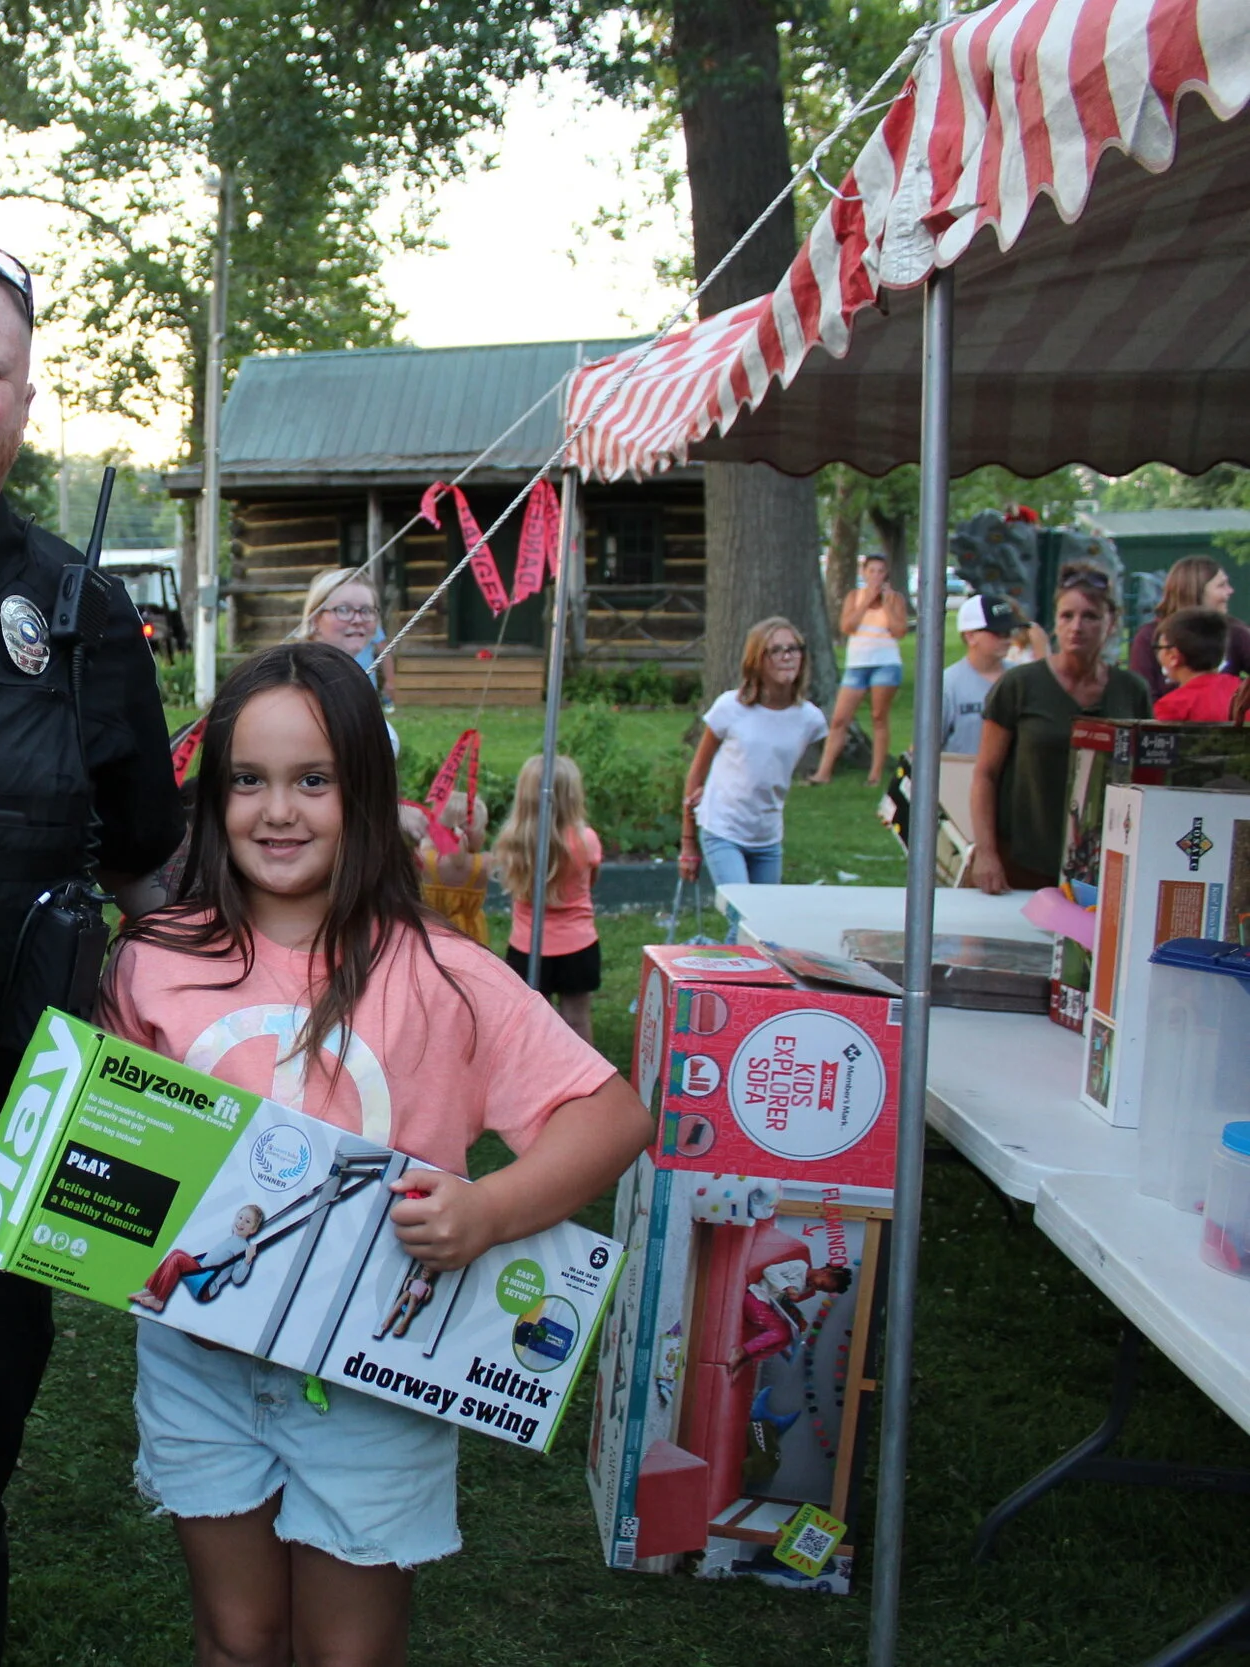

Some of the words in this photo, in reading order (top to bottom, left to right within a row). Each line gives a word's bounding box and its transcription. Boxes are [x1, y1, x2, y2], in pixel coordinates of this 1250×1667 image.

[1190, 818, 1203, 871] MOSAIC
[99, 1055, 241, 1124] playzone-fit
[745, 1057, 770, 1105] SOFA
[766, 1035, 797, 1132] EXPLORER
[822, 1069, 834, 1101] 4-PIECE
[84, 1103, 97, 1115] just
[96, 1107, 119, 1123] gravity
[118, 1115, 132, 1126] and
[113, 1101, 136, 1117] needed
[136, 1110, 147, 1121] for
[205, 1114, 234, 1132] Everyday
[840, 1105, 851, 1127] Mark
[78, 1116, 103, 1133] Storage
[102, 1124, 116, 1138] bag
[115, 1127, 142, 1146] included
[66, 1151, 111, 1180] PLAY.
[257, 1172, 287, 1189] WINNER
[56, 1178, 91, 1199] Active
[92, 1191, 123, 1212] today
[124, 1202, 141, 1217] for
[50, 1194, 58, 1204] a
[60, 1195, 101, 1222] healthy
[103, 1212, 154, 1238] tomorrow
[50, 1262, 60, 1272] top
[59, 1266, 76, 1277] panel
[53, 1274, 91, 1292] specifications
[516, 1269, 537, 1282] EASY
[509, 1279, 542, 1296] MINUTE
[465, 1356, 553, 1409] kidtrix
[343, 1351, 459, 1415] doorway
[459, 1402, 540, 1444] swing
